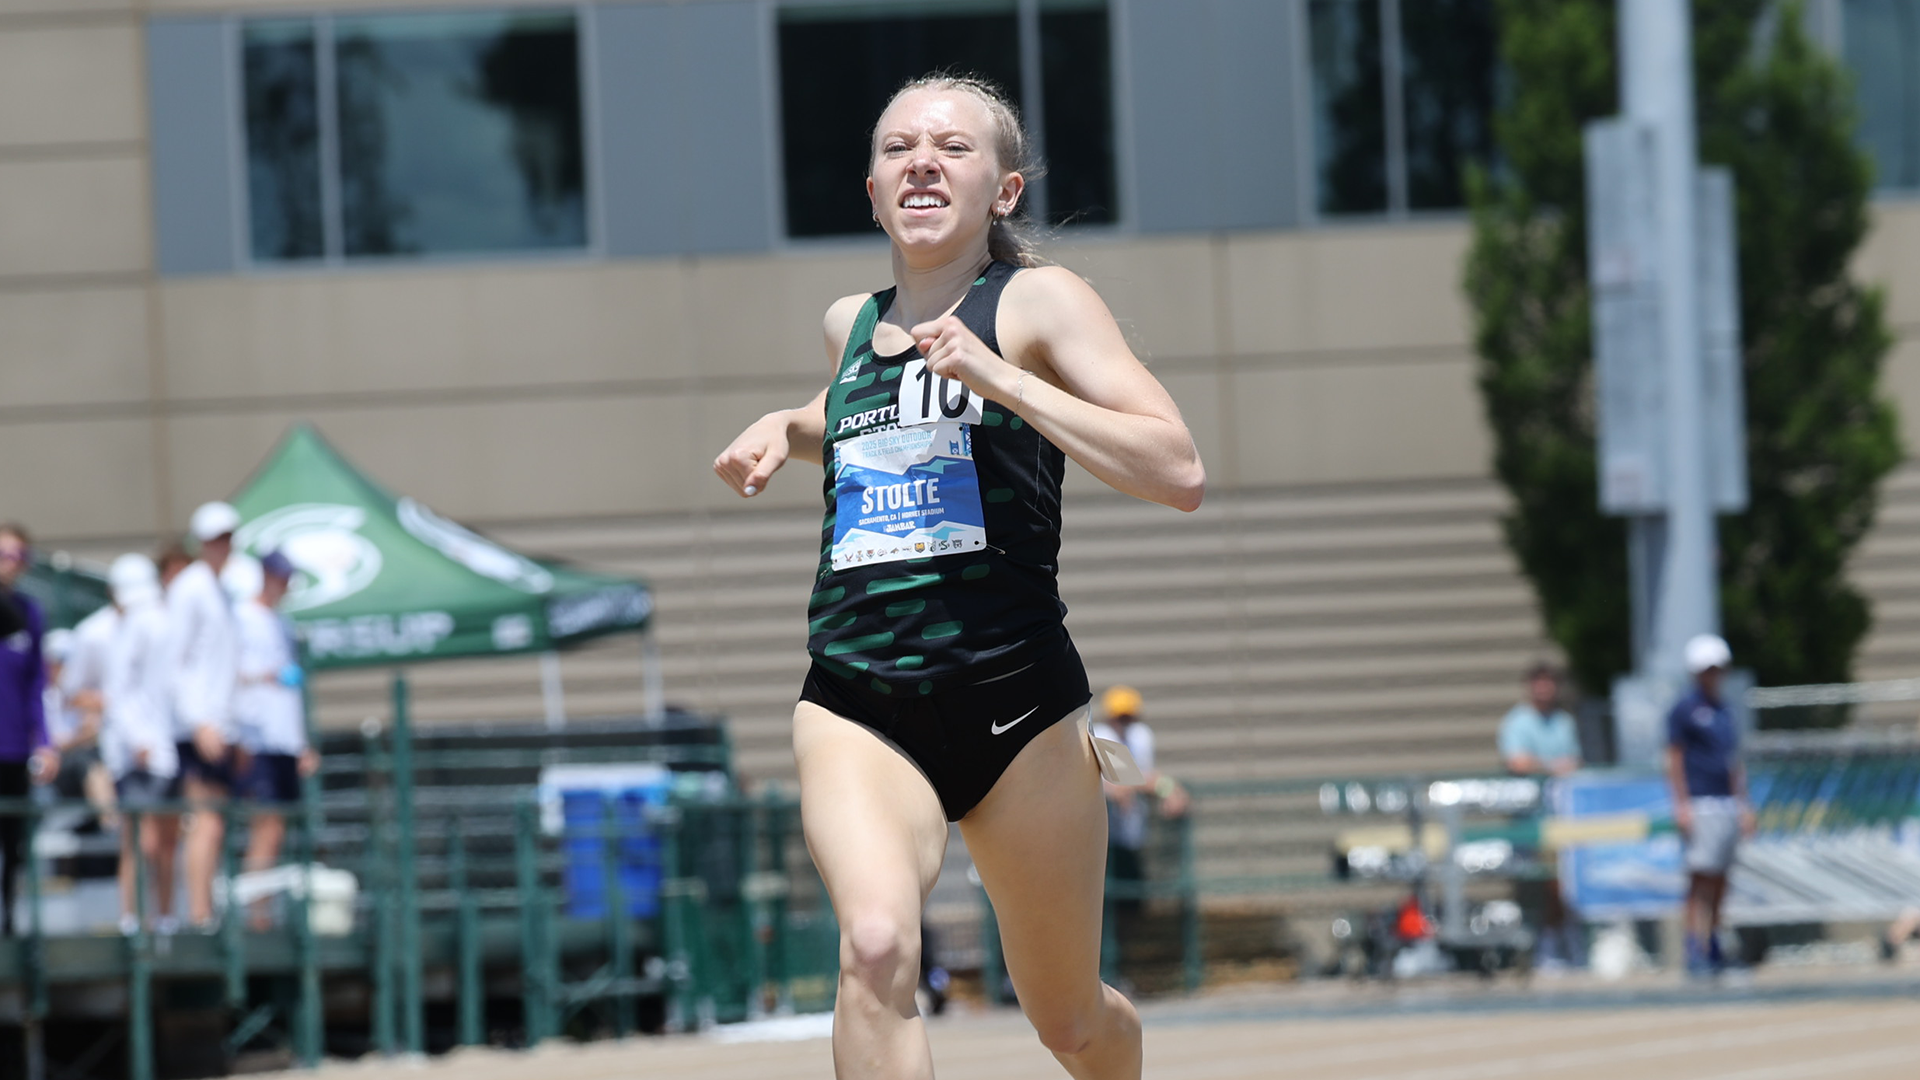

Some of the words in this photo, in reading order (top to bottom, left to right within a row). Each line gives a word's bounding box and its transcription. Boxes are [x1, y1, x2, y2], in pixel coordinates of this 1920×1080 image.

[915, 365, 970, 419] 10
[838, 404, 900, 434] PORTL
[878, 437, 888, 448] BIG
[889, 435, 900, 446] SKY
[901, 430, 932, 443] OUTDOOR
[861, 477, 940, 514] STOLTE
[890, 513, 897, 521] CA
[921, 507, 945, 516] STADIUM
